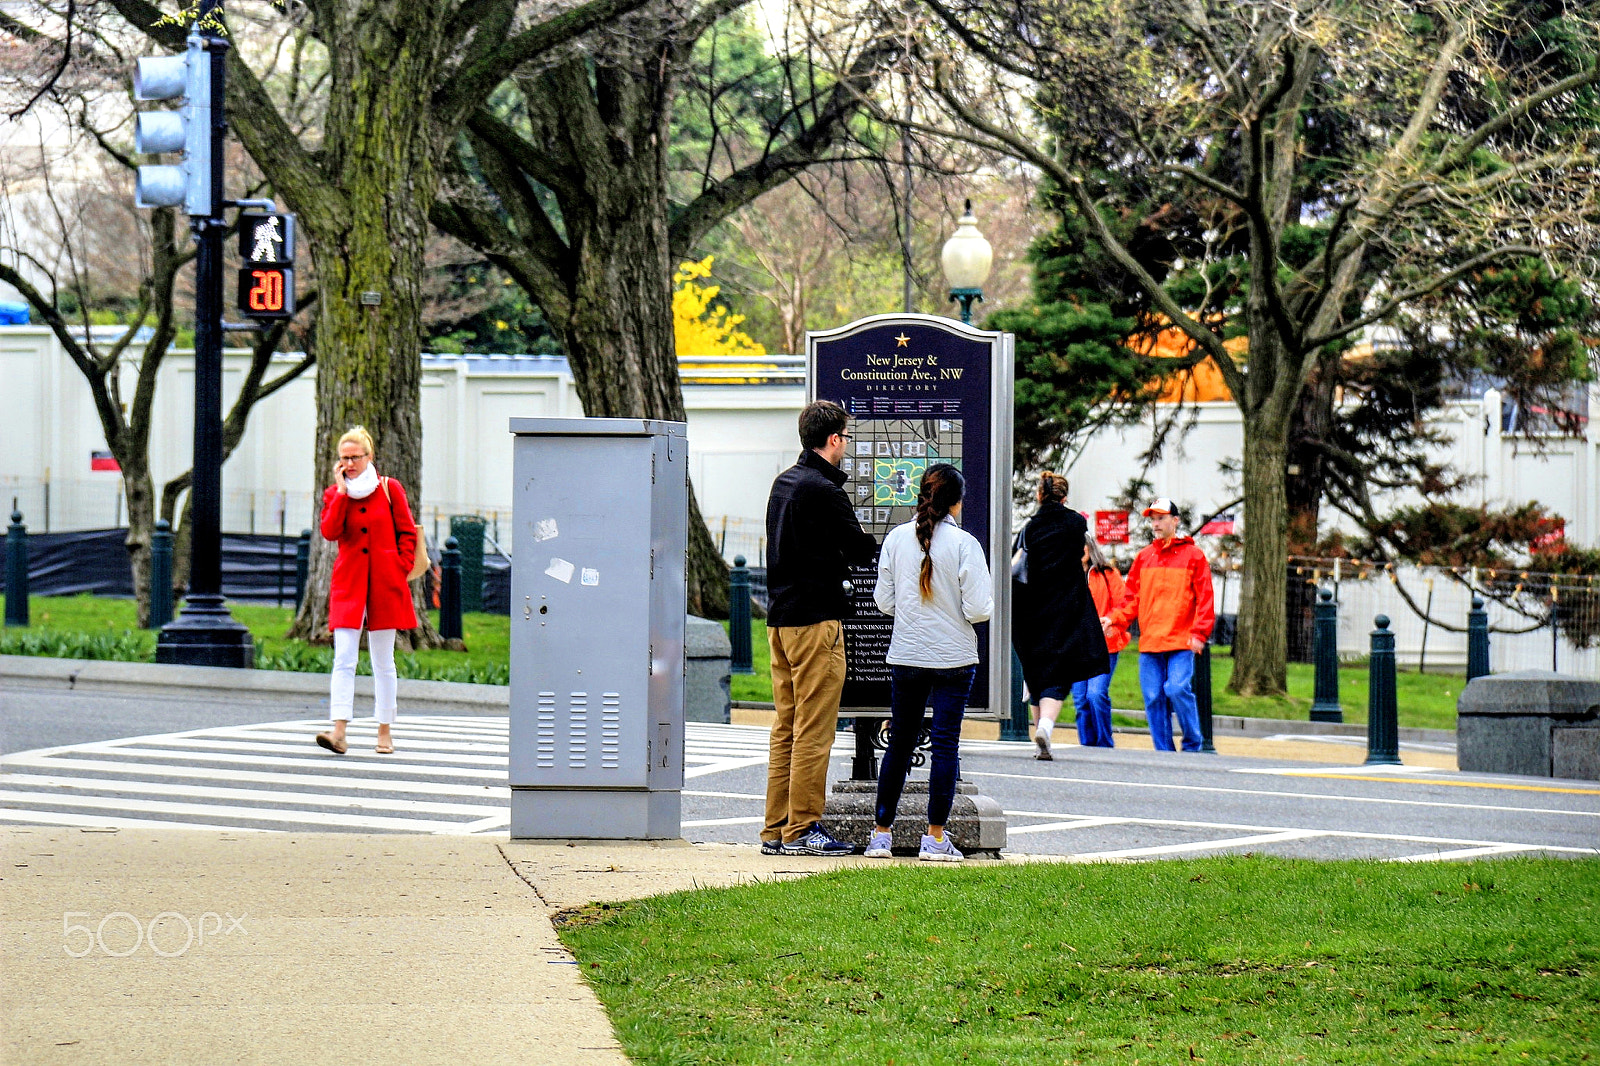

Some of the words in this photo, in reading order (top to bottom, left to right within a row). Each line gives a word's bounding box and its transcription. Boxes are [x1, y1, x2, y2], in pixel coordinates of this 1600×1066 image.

[249, 270, 283, 310] 20
[866, 354, 891, 366] New
[893, 354, 924, 368] Jersey
[927, 354, 938, 366] &
[841, 368, 907, 380] Constitution
[910, 368, 937, 381] Ave.,
[940, 368, 963, 380] NW
